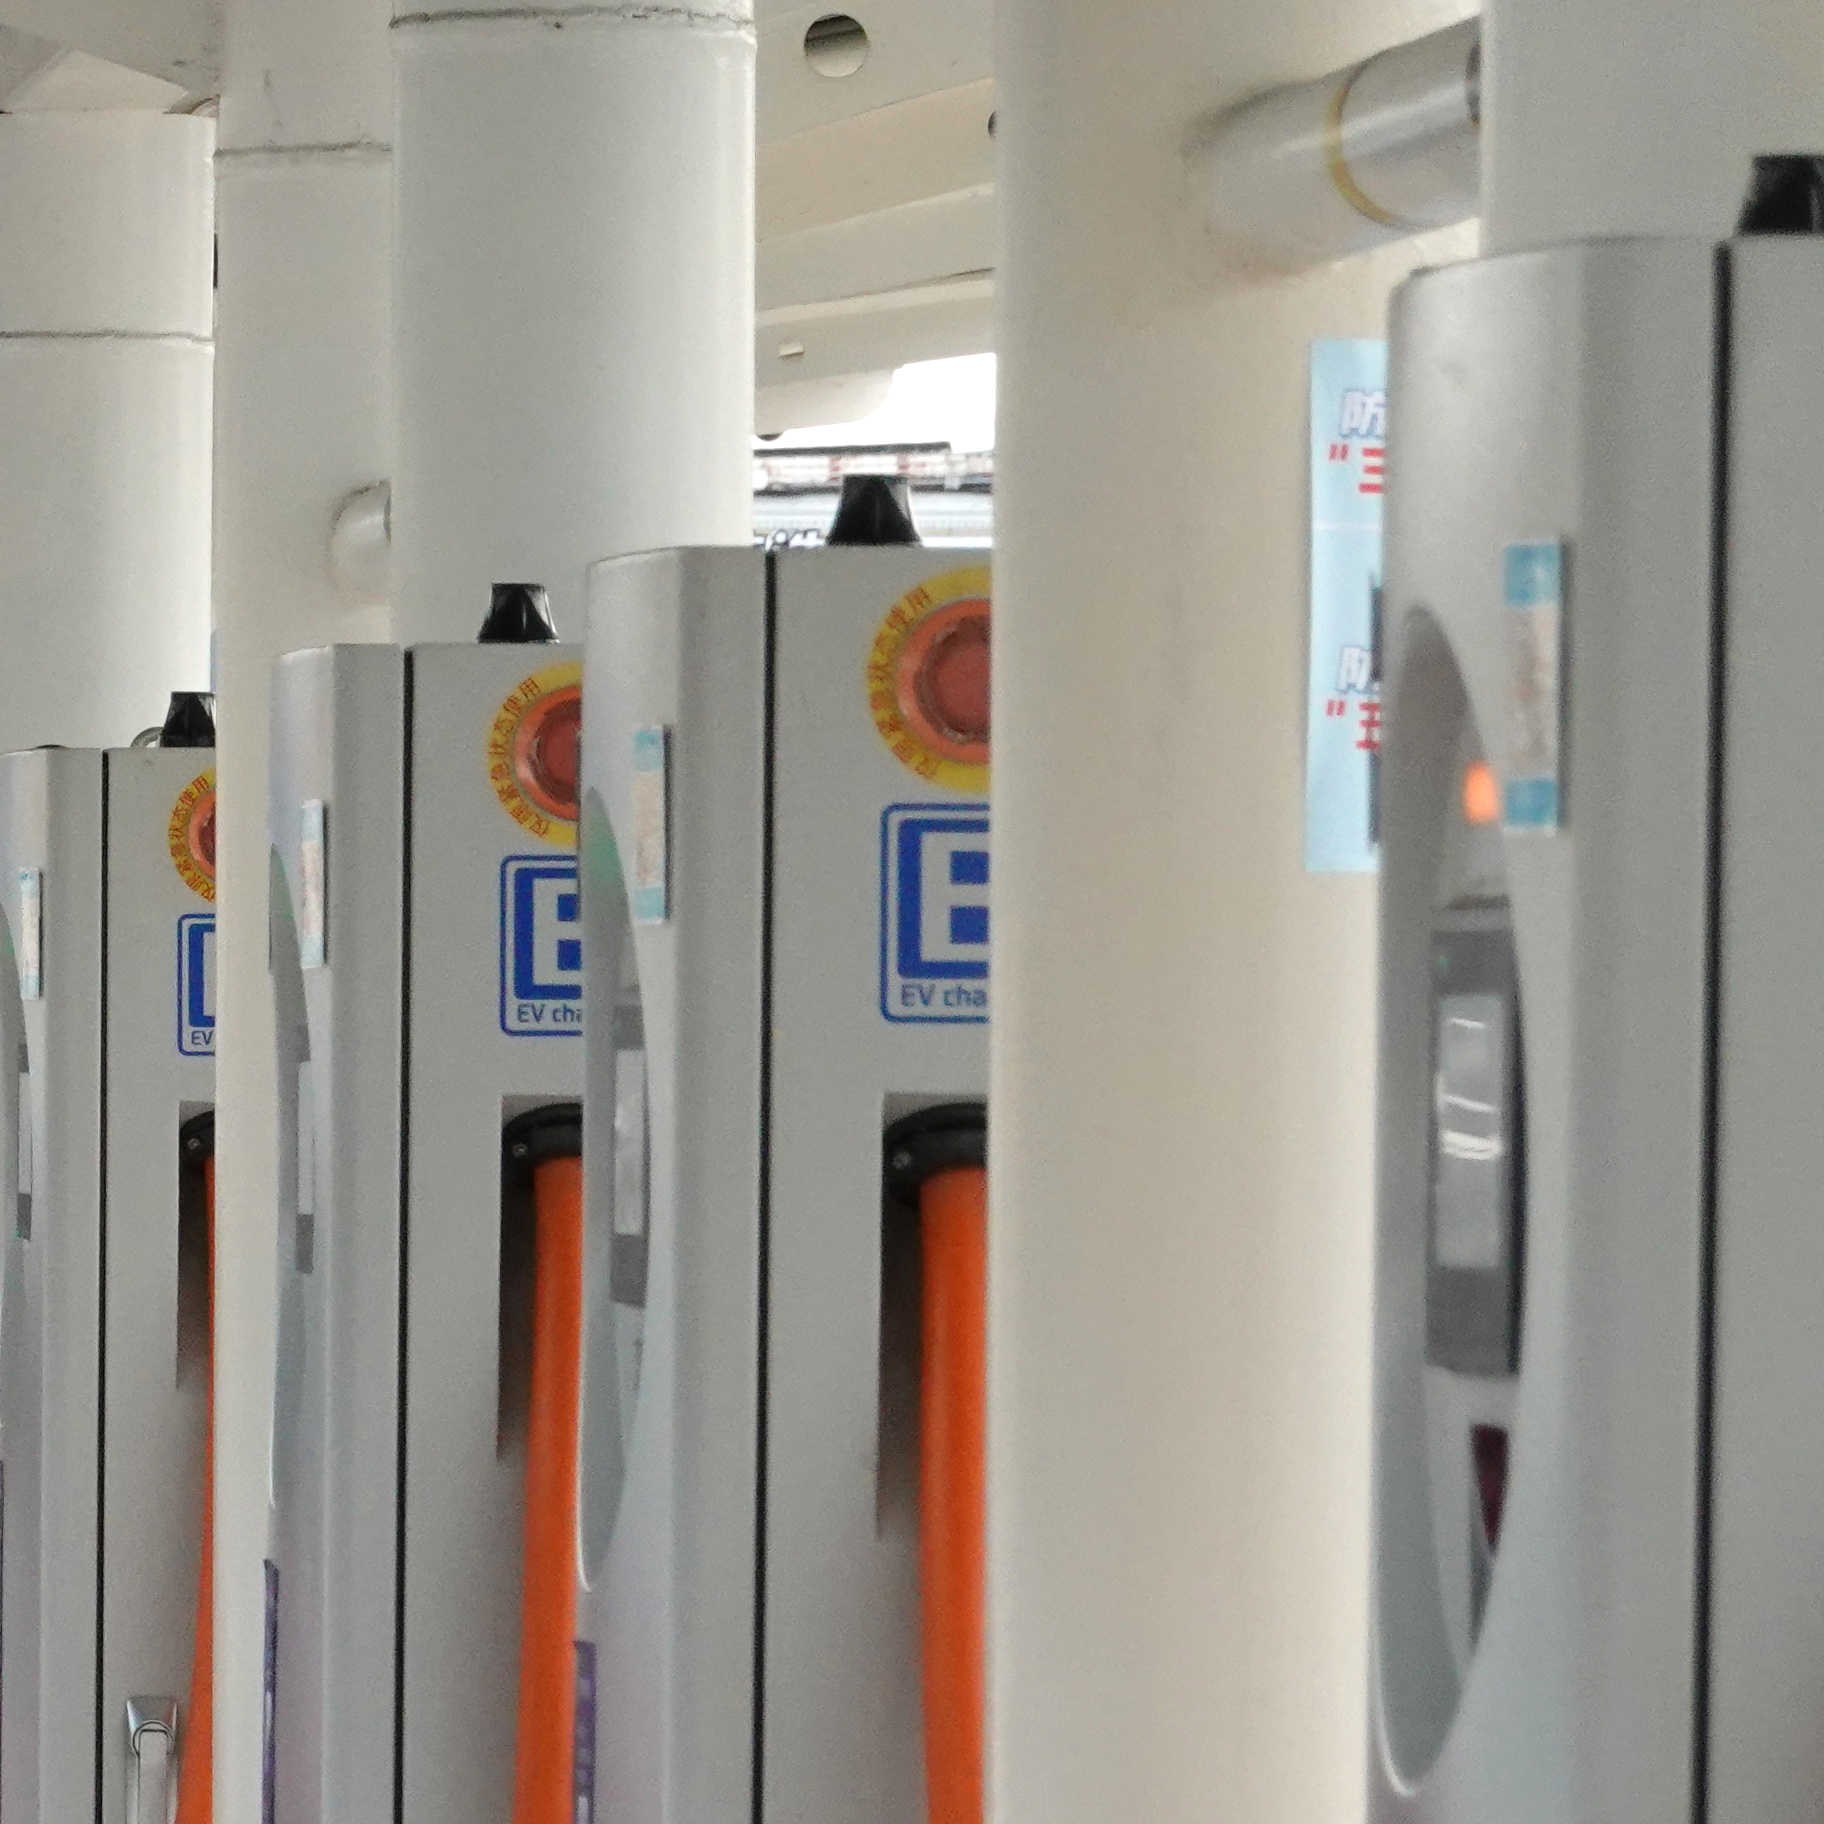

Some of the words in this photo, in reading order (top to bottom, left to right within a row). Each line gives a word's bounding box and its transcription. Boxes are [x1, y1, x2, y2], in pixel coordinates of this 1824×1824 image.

[901, 984, 935, 1007] EV
[517, 1003, 545, 1023] EV
[191, 1030, 214, 1046] EV
